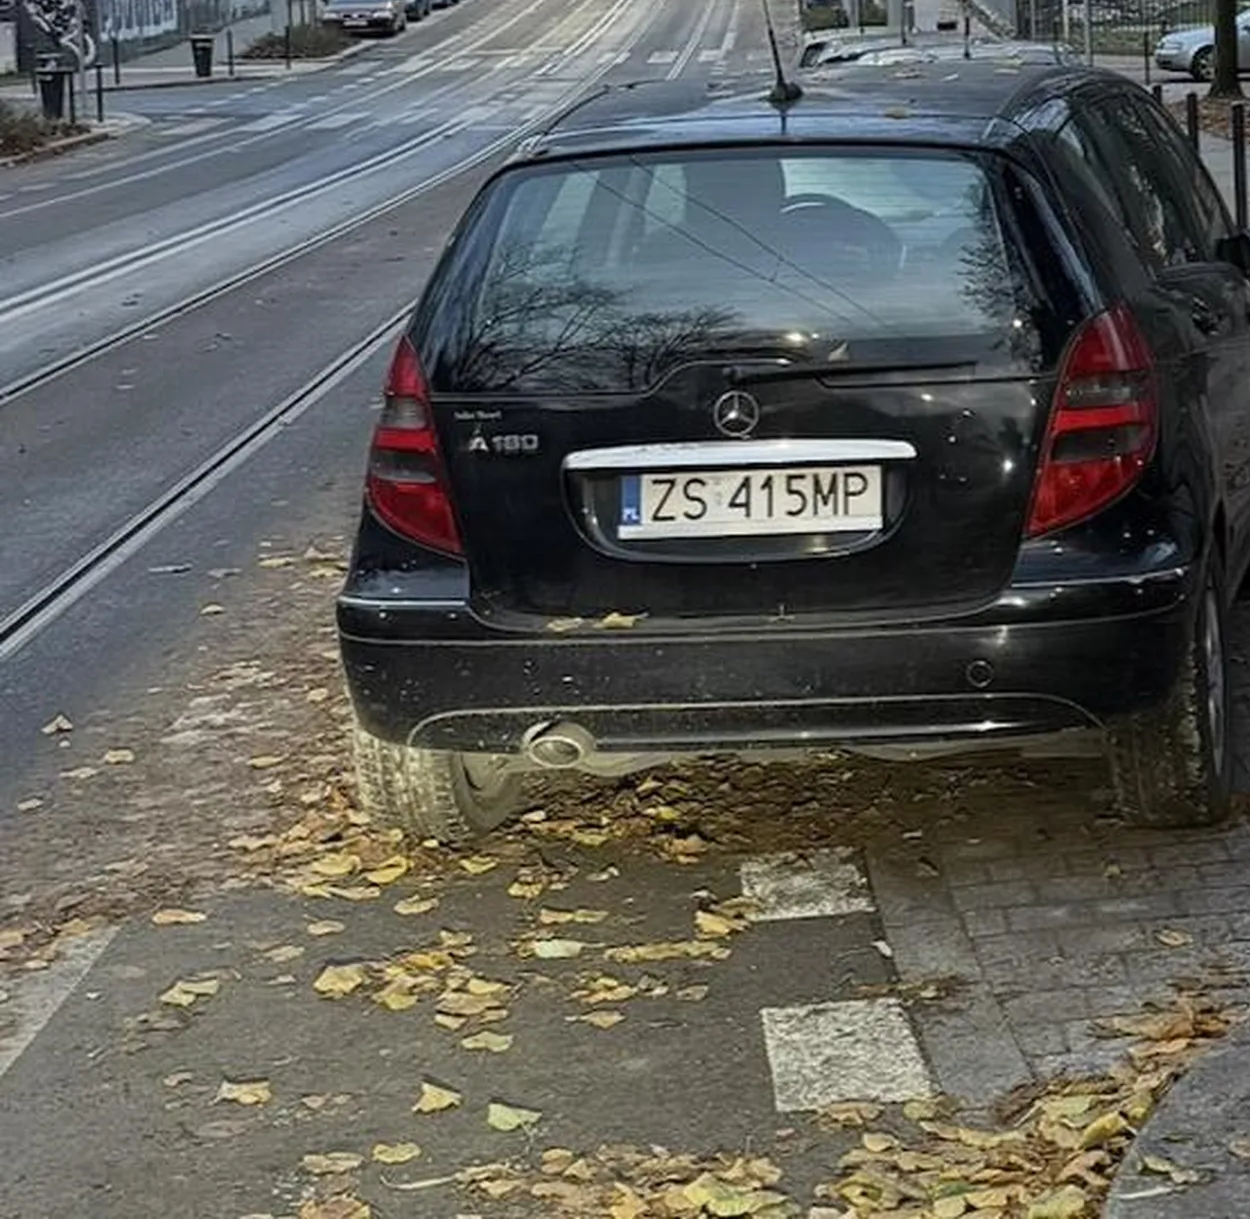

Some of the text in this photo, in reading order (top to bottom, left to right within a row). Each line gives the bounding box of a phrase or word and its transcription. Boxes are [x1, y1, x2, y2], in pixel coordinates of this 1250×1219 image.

[651, 471, 869, 521] ZS 415MP
[623, 508, 640, 520] PL
